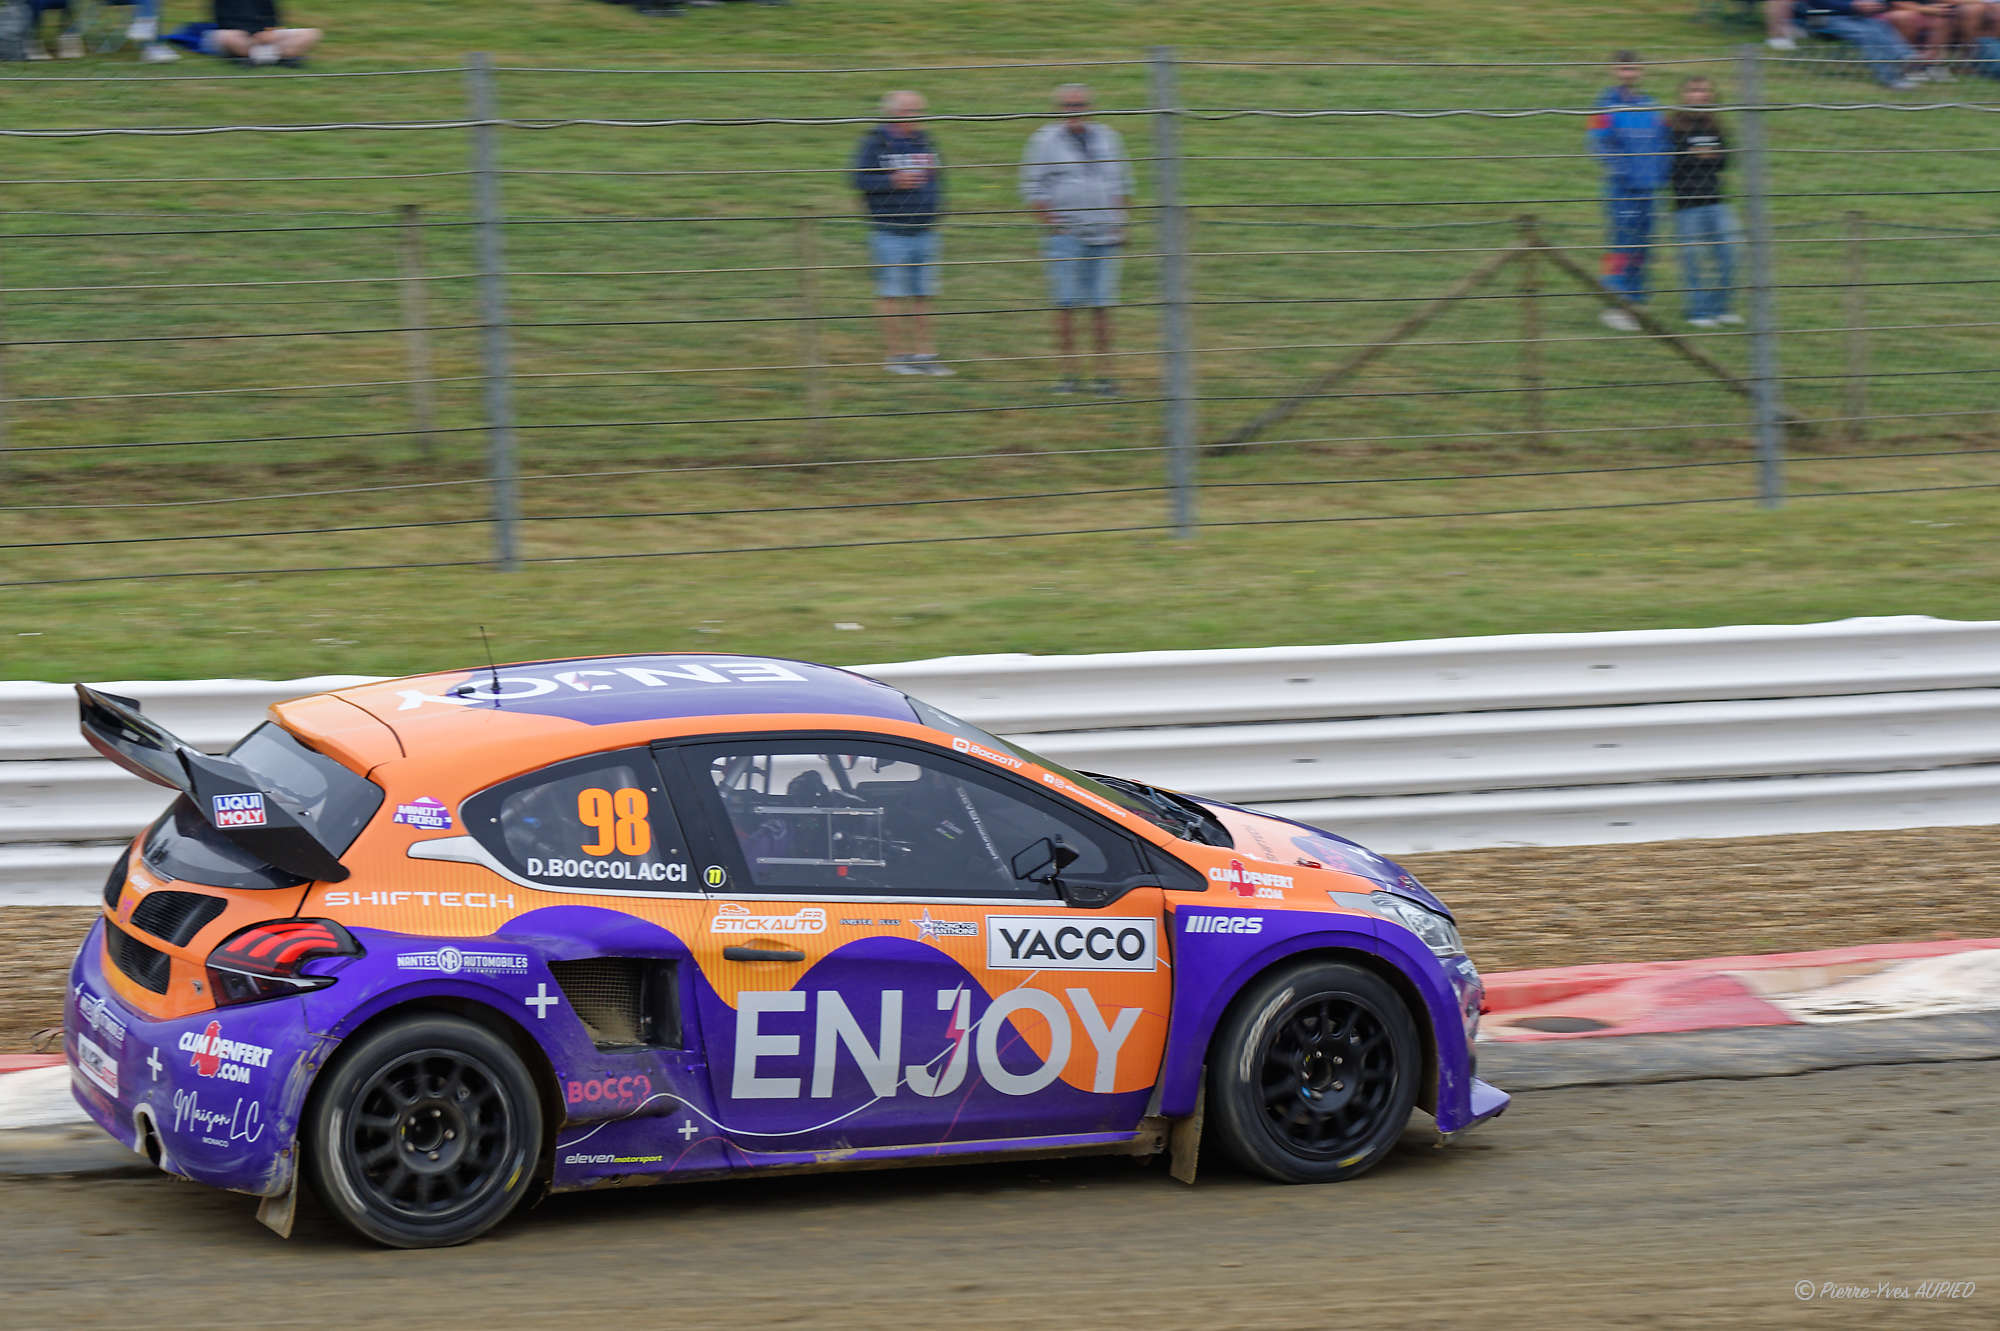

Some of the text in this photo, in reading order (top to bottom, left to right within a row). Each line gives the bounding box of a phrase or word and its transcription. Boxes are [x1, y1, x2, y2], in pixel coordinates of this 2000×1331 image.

[217, 795, 260, 810] LIQUI
[219, 809, 263, 825] MOLY
[577, 787, 651, 857] 98
[527, 857, 687, 882] D.BOCCOLACCI
[1208, 867, 1294, 889] CLIM DENFERT
[324, 891, 515, 909] SHIFTECH
[998, 926, 1146, 961] YACCO
[397, 955, 437, 967] NANTES
[463, 956, 528, 968] AUTOMOBILES
[178, 1031, 273, 1068] CLIM DENFERT
[731, 981, 1143, 1099] ENJOY
[217, 1062, 250, 1084] .COM
[173, 1088, 264, 1142] Maison LC
